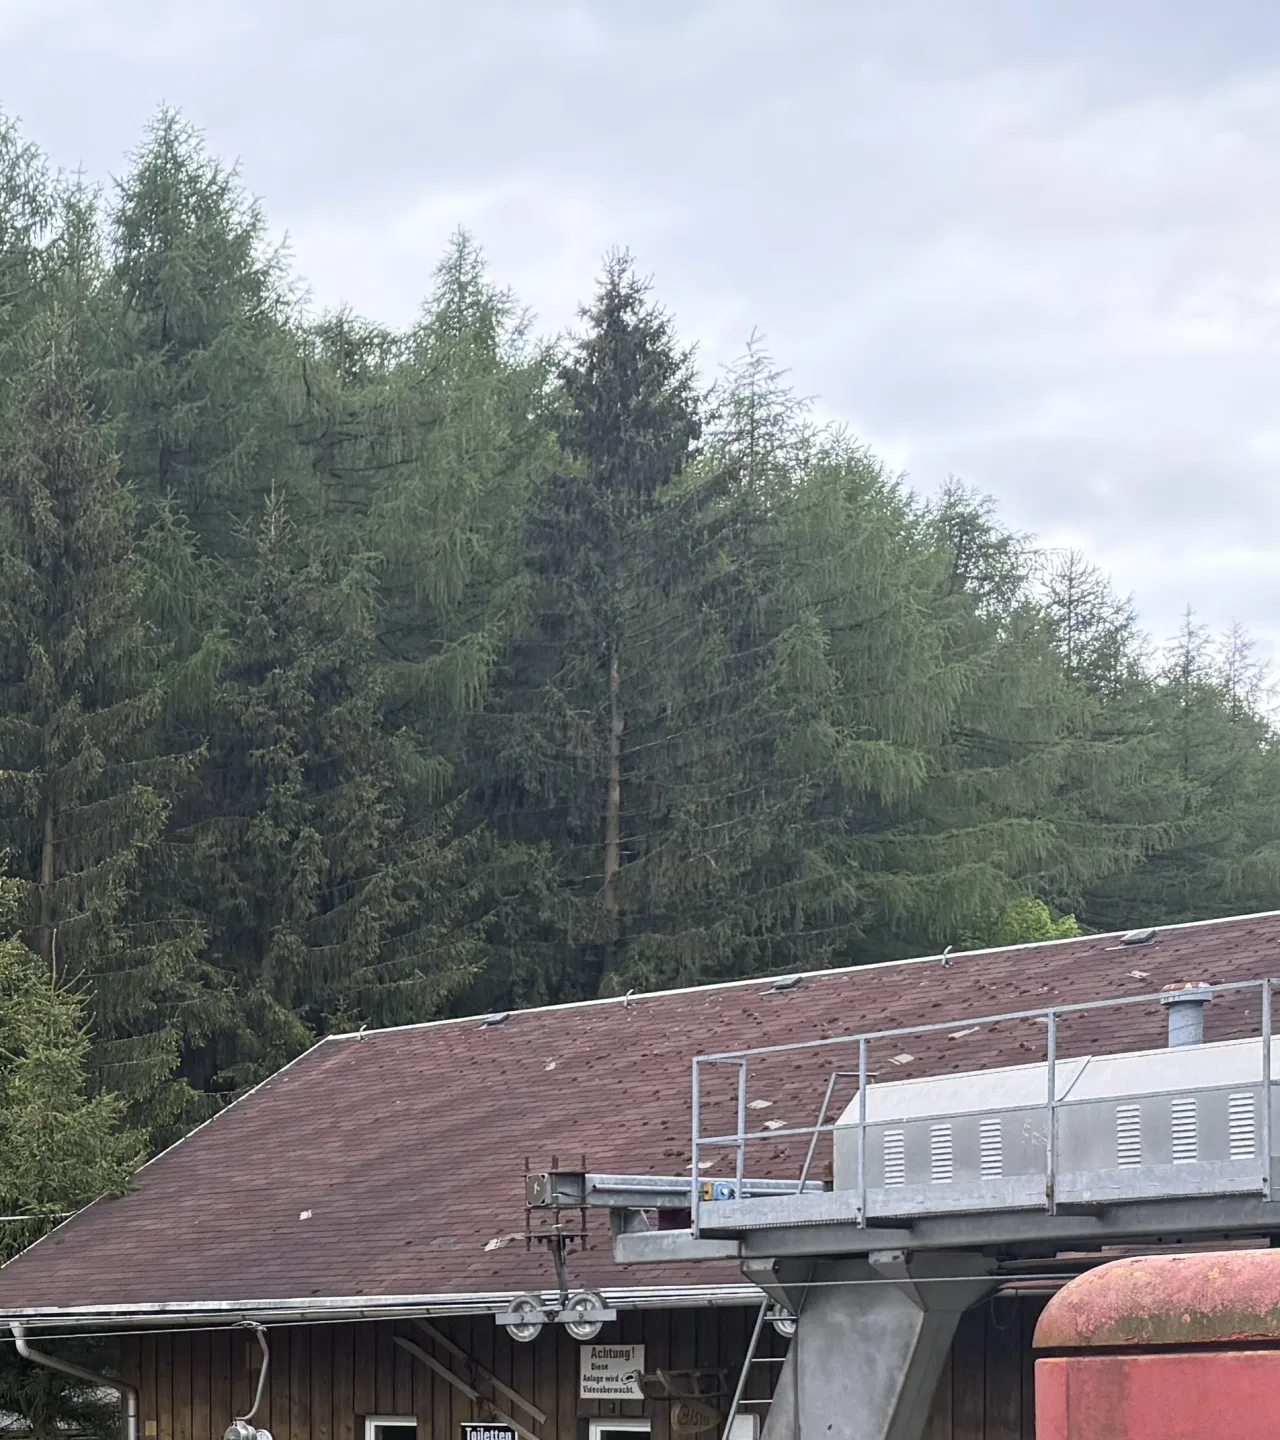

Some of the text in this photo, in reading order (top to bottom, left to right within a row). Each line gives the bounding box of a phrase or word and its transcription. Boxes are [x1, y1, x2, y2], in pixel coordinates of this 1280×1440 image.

[591, 1346, 635, 1361] Achtung!
[583, 1374, 619, 1384] Anlage wird
